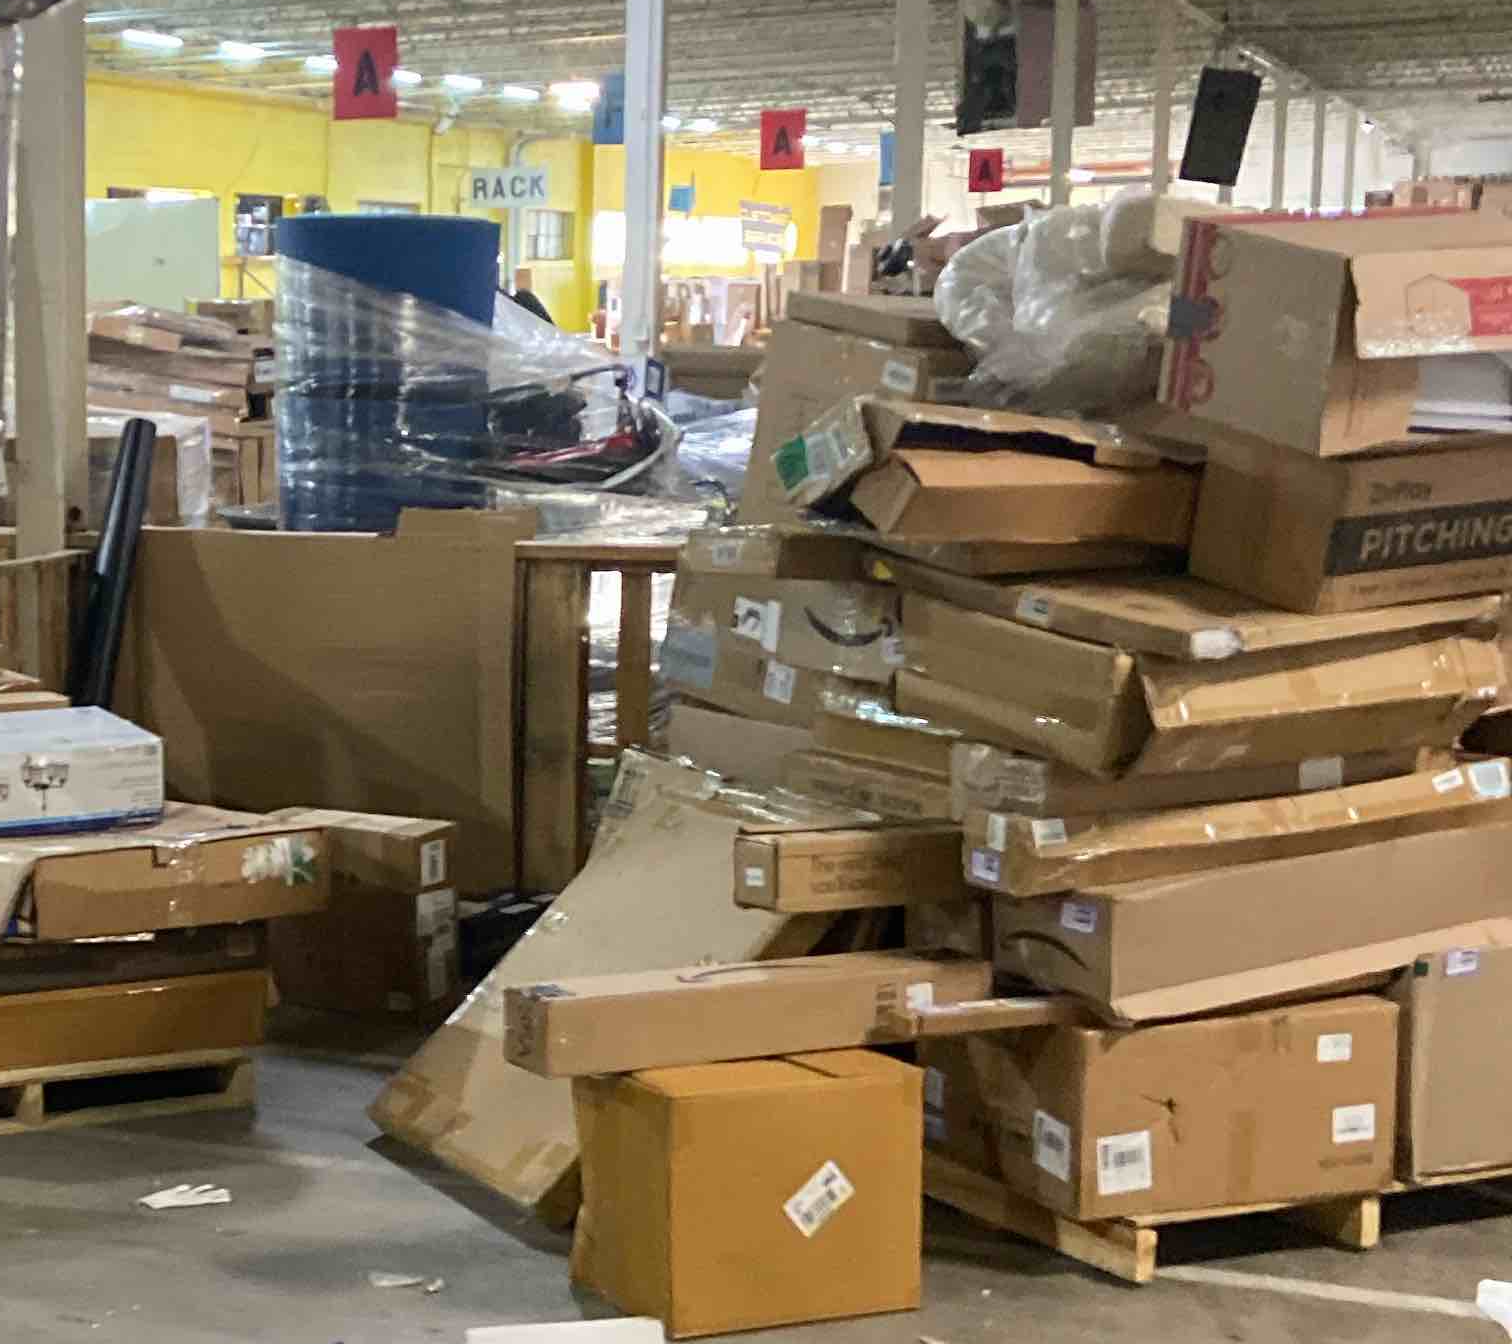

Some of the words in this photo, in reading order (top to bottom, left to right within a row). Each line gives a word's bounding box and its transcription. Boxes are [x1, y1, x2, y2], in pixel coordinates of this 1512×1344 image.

[354, 49, 379, 96] A
[773, 125, 792, 155] A
[473, 175, 544, 200] RACK
[1359, 513, 1512, 560] PITCHING
